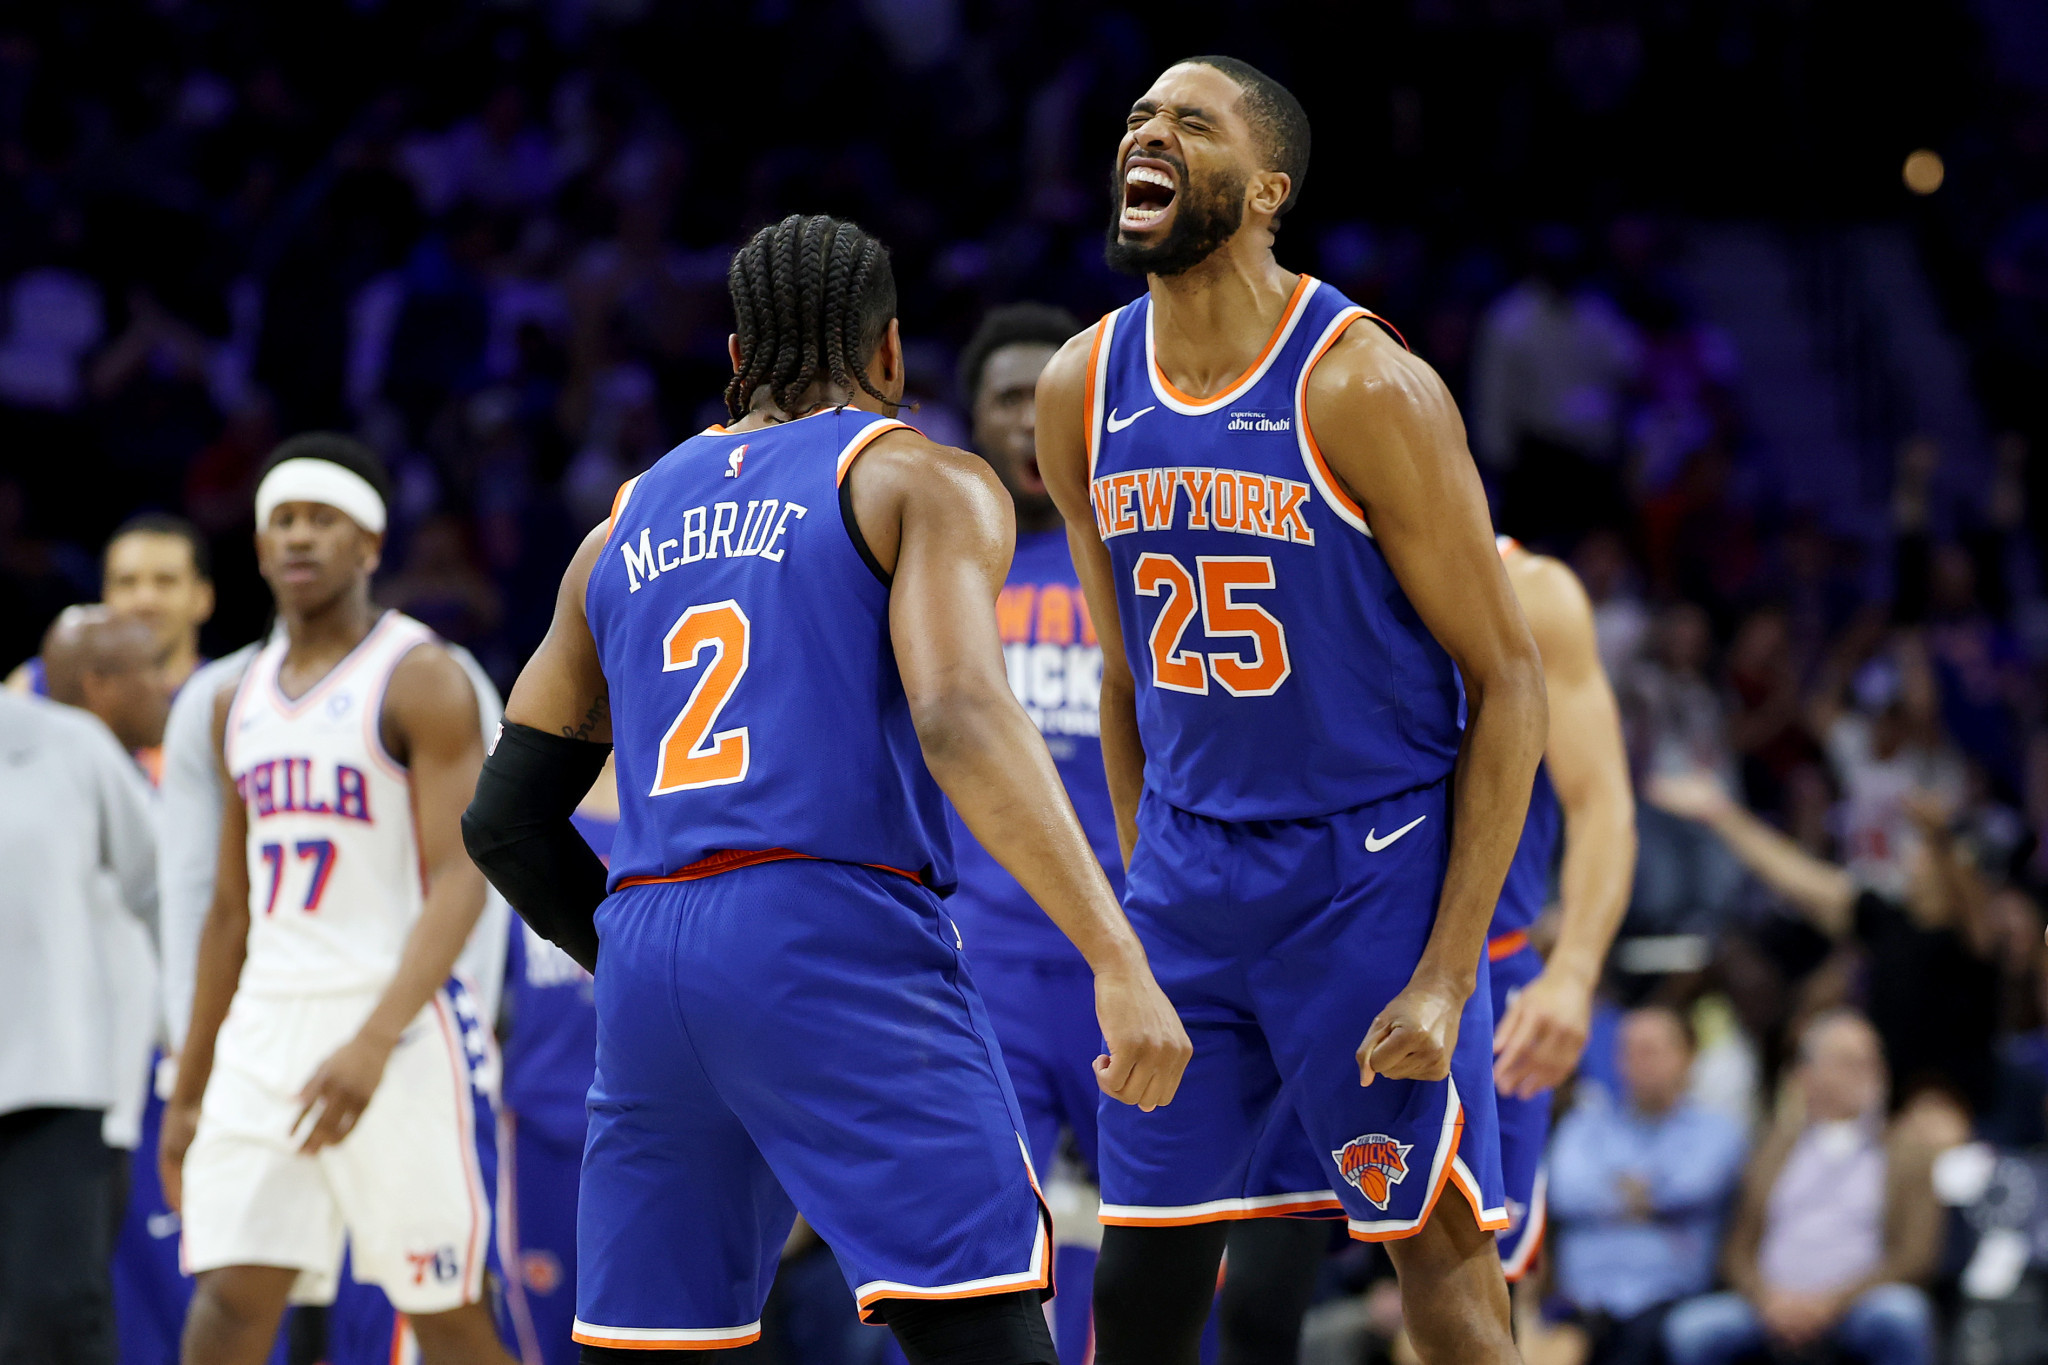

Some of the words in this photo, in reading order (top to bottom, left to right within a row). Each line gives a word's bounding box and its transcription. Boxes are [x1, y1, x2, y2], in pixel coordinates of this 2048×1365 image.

[1227, 418, 1253, 431] abu
[1255, 418, 1290, 431] dhabi
[621, 499, 807, 593] McBRIDE
[1091, 467, 1177, 542] NEW
[1178, 467, 1315, 546] YORK
[1133, 552, 1291, 697] 25
[649, 598, 750, 797] 2
[261, 840, 337, 915] 77
[1341, 1141, 1404, 1176] KNICKS
